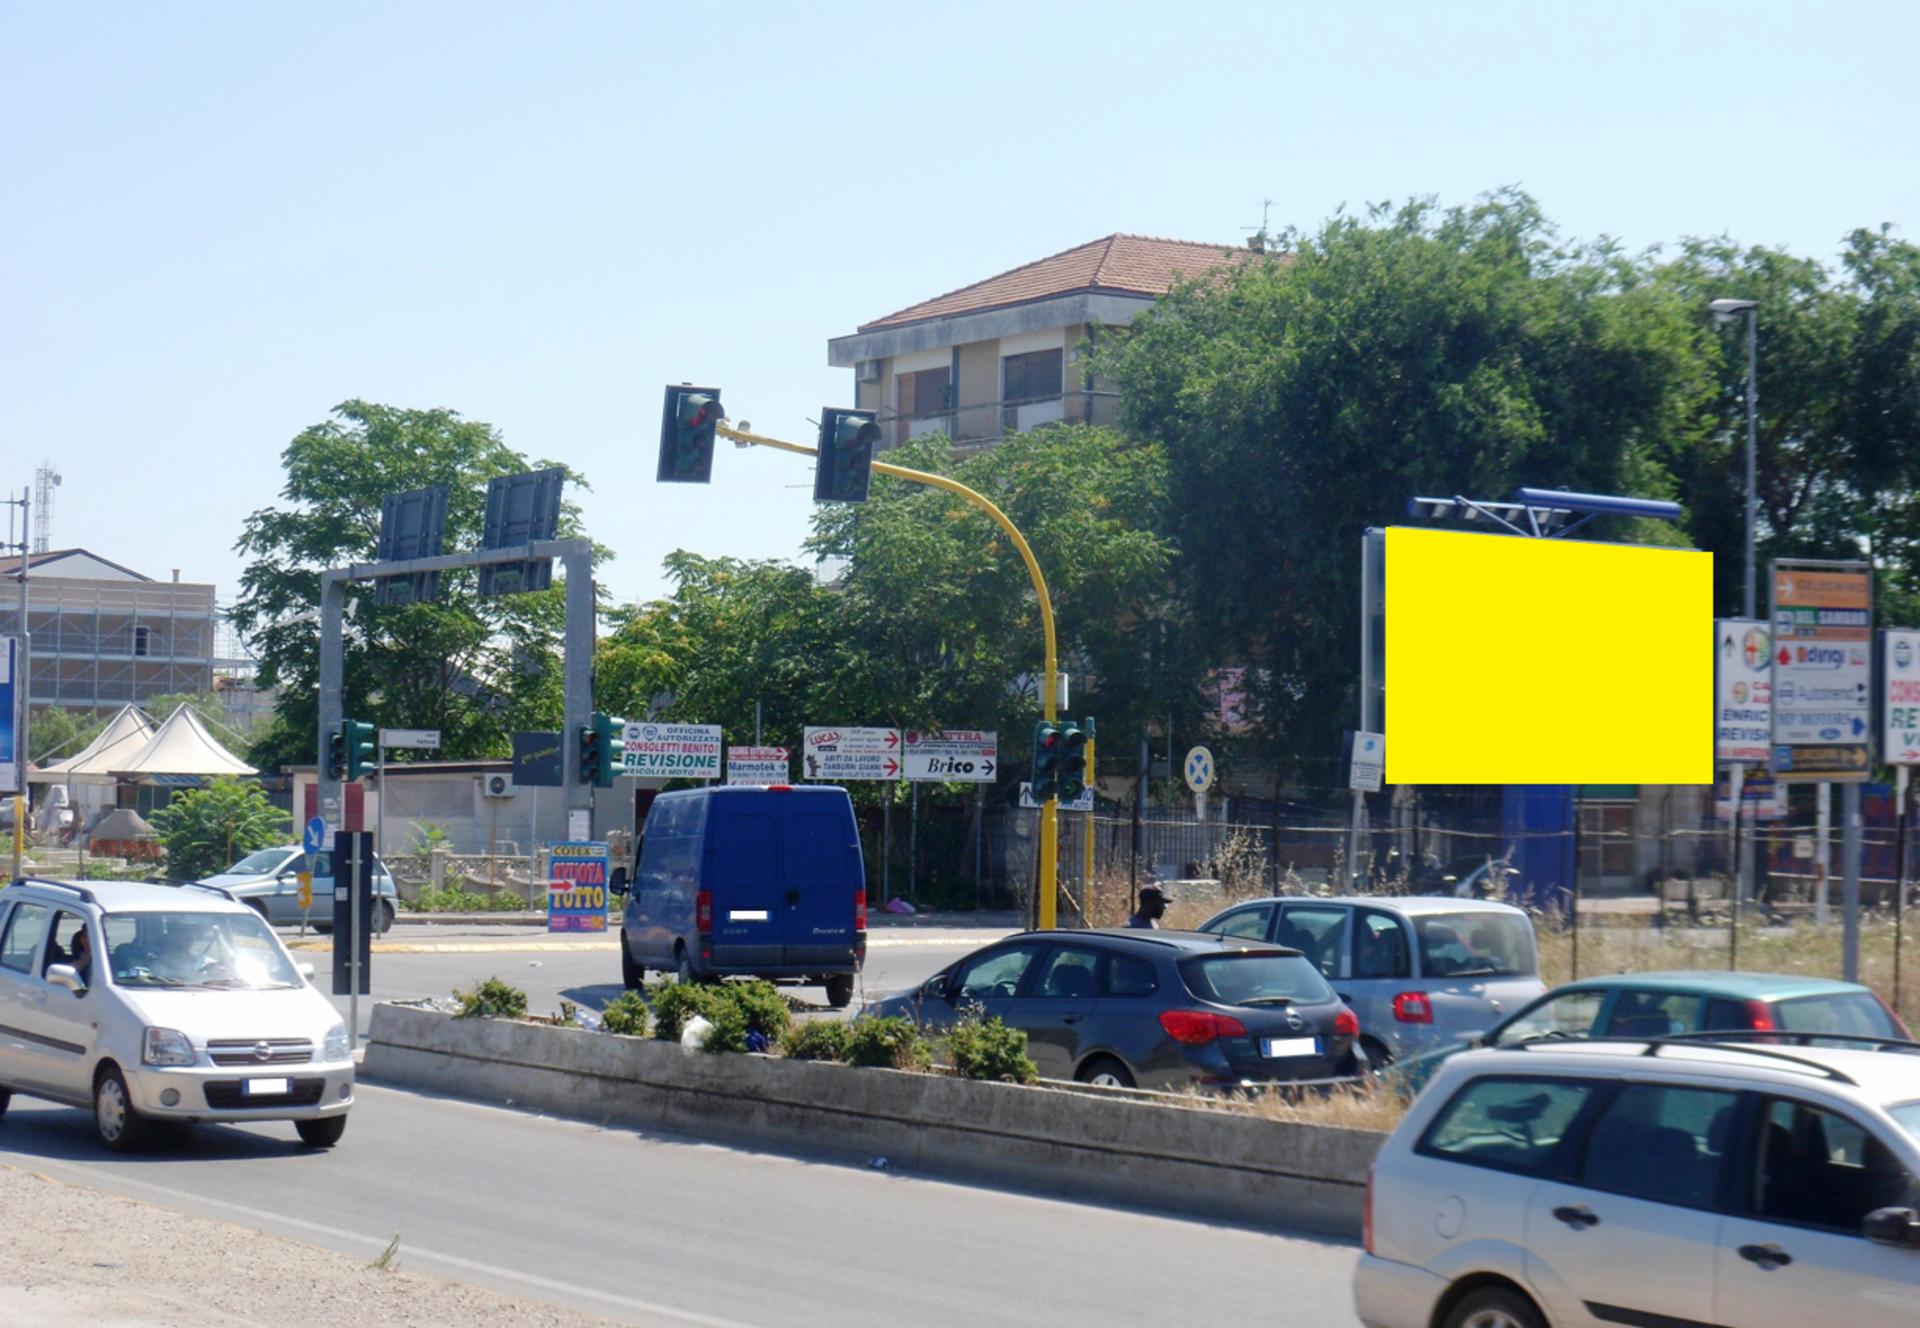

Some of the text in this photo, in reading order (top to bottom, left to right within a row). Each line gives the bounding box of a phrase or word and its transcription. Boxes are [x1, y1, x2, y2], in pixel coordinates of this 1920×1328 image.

[667, 727, 711, 736] OFFICINA
[656, 735, 721, 743] AUTORIZZATA
[624, 753, 718, 768] REVISIONE
[927, 756, 975, 774] Brico
[728, 761, 776, 771] Marmotek
